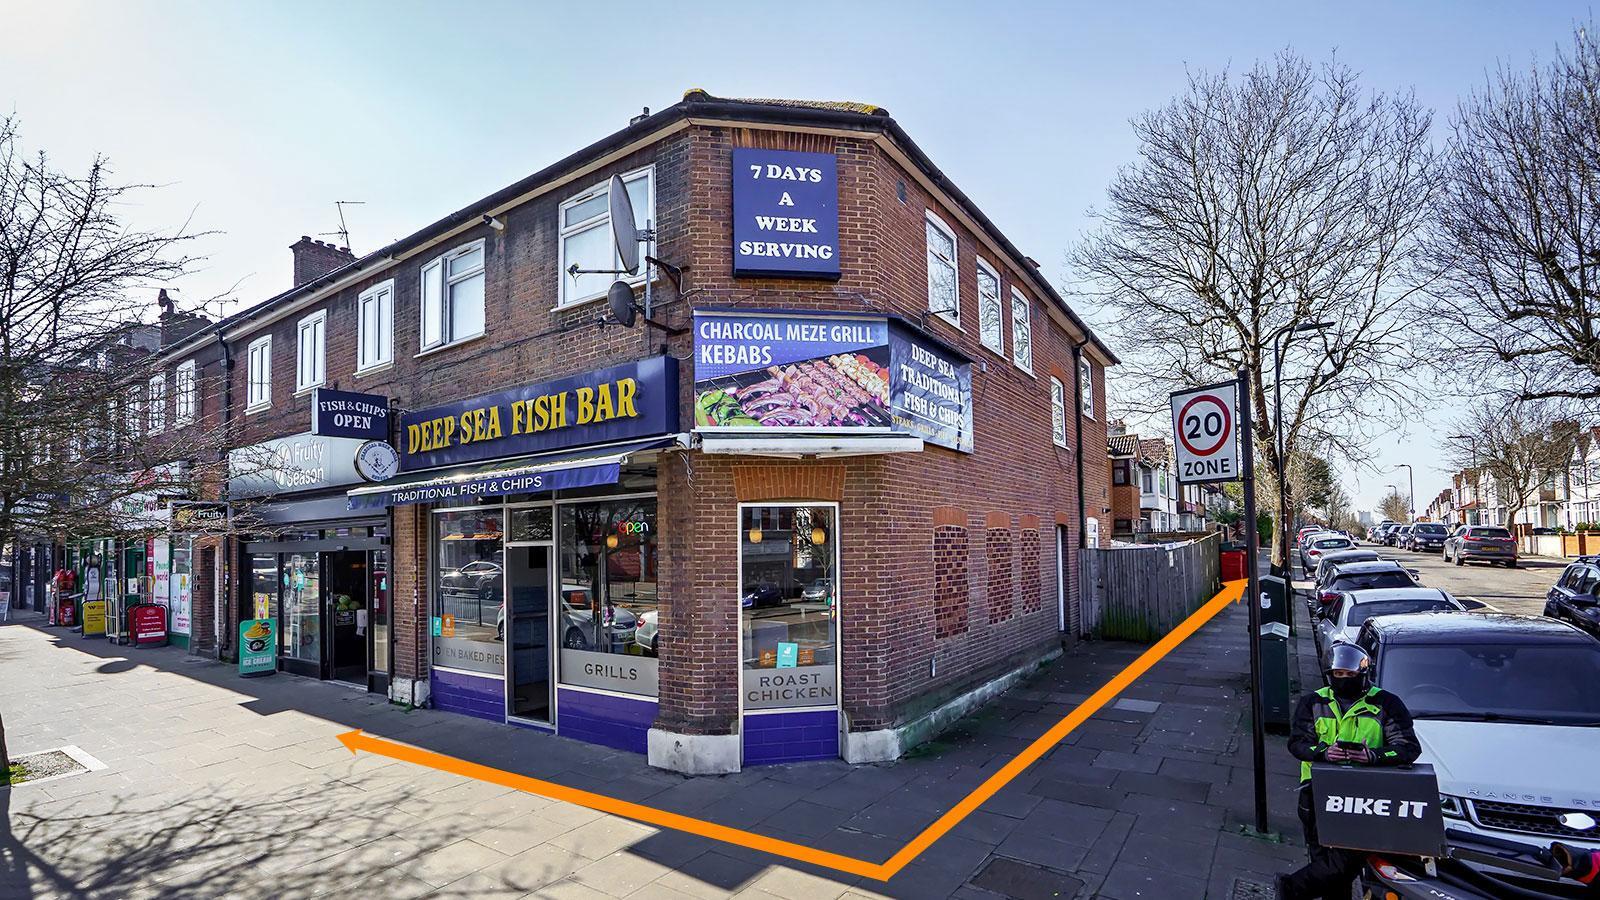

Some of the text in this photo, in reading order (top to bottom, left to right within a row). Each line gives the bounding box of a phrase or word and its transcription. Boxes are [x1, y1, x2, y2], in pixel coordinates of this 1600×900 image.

[750, 164, 822, 183] 7 DAYS
[778, 191, 795, 206] A
[755, 215, 818, 233] WEEK
[740, 241, 833, 259] SERVING
[700, 322, 874, 343] CHARCOAL MEZE GRILL
[701, 344, 772, 365] KEBABS
[911, 343, 956, 380] DEEP SEA
[900, 363, 966, 407] TRADITIONAL
[407, 377, 638, 455] DEEP SEA FISH BAR
[904, 390, 965, 428] FISH & CHIPS
[334, 413, 372, 429] OPEN
[1185, 411, 1222, 440] 20
[294, 440, 325, 463] Fruity
[1183, 457, 1231, 477] ZONE
[391, 486, 457, 503] TRADITIONAL
[459, 482, 487, 496] FISH
[488, 481, 498, 493] &
[501, 475, 542, 491] CHIPS
[198, 510, 226, 519] Fruity
[617, 521, 649, 536] open
[458, 649, 485, 662] BAKED
[486, 653, 505, 665] PIES
[584, 663, 638, 681] GRILLS
[759, 673, 821, 687] ROAST
[747, 686, 833, 702] CHICKEN
[1467, 787, 1553, 803] RANGE
[1325, 795, 1428, 819] BIKE IT
